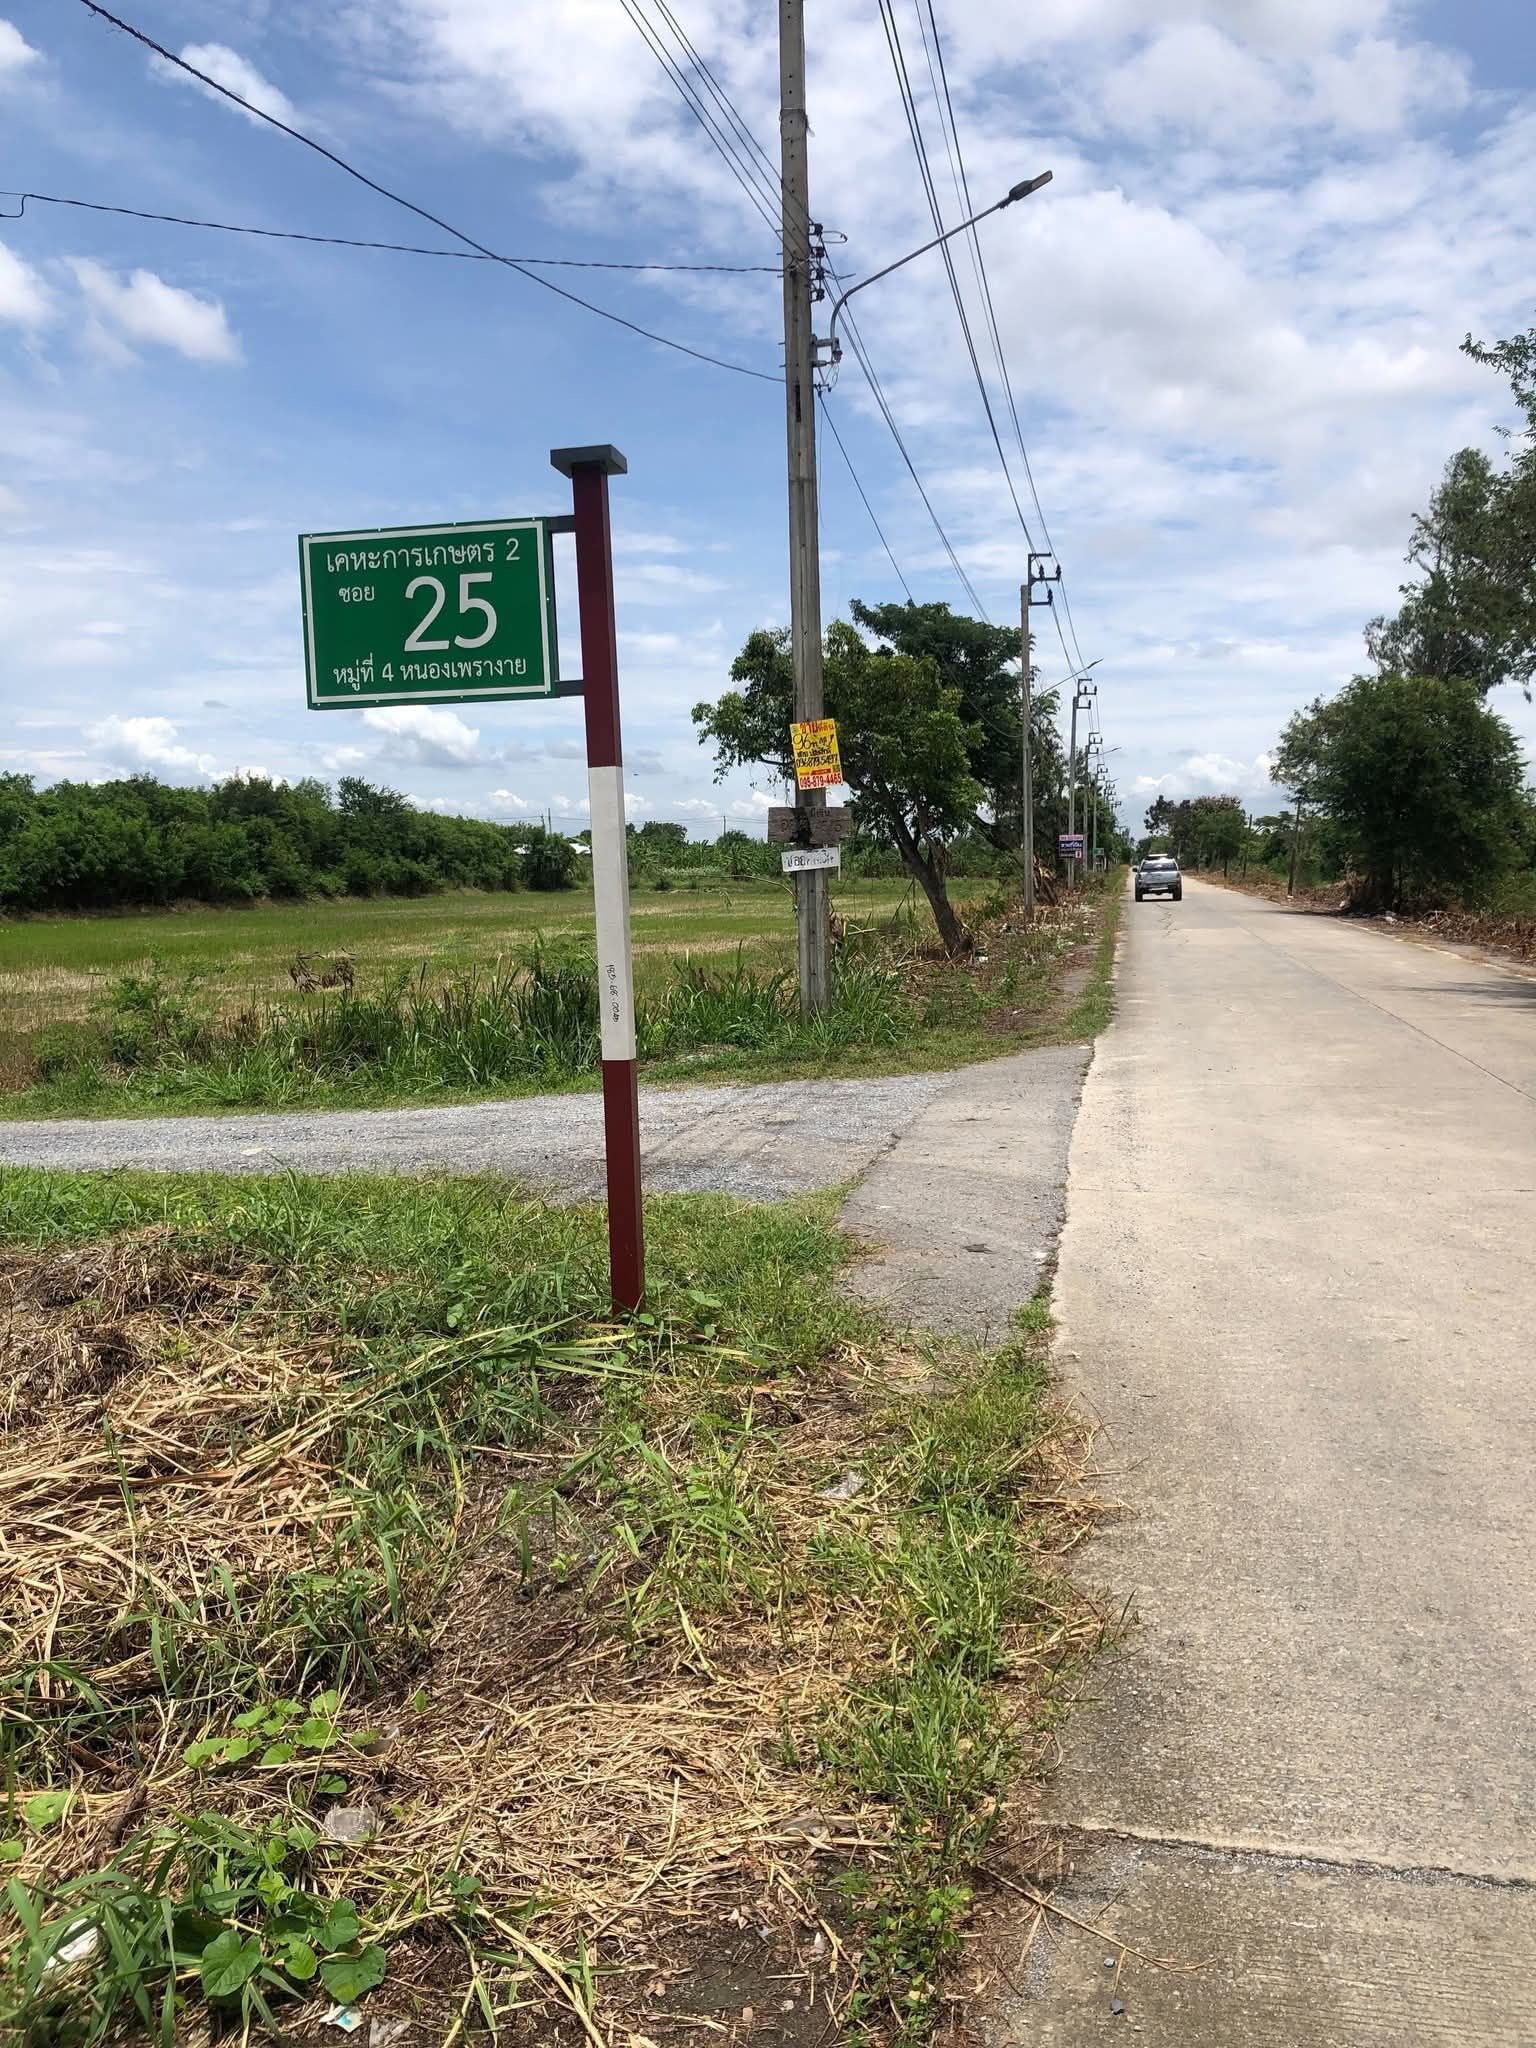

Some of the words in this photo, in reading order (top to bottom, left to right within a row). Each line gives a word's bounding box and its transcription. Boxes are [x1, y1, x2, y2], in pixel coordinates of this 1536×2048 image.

[326, 542, 495, 573] เคหะการเกษตร
[505, 538, 520, 561] 2
[338, 585, 375, 603] ซอย
[404, 572, 498, 652] 25
[333, 653, 374, 691] หมู่ที่
[382, 662, 394, 682] 4
[400, 658, 527, 681] หนองเพรางาย
